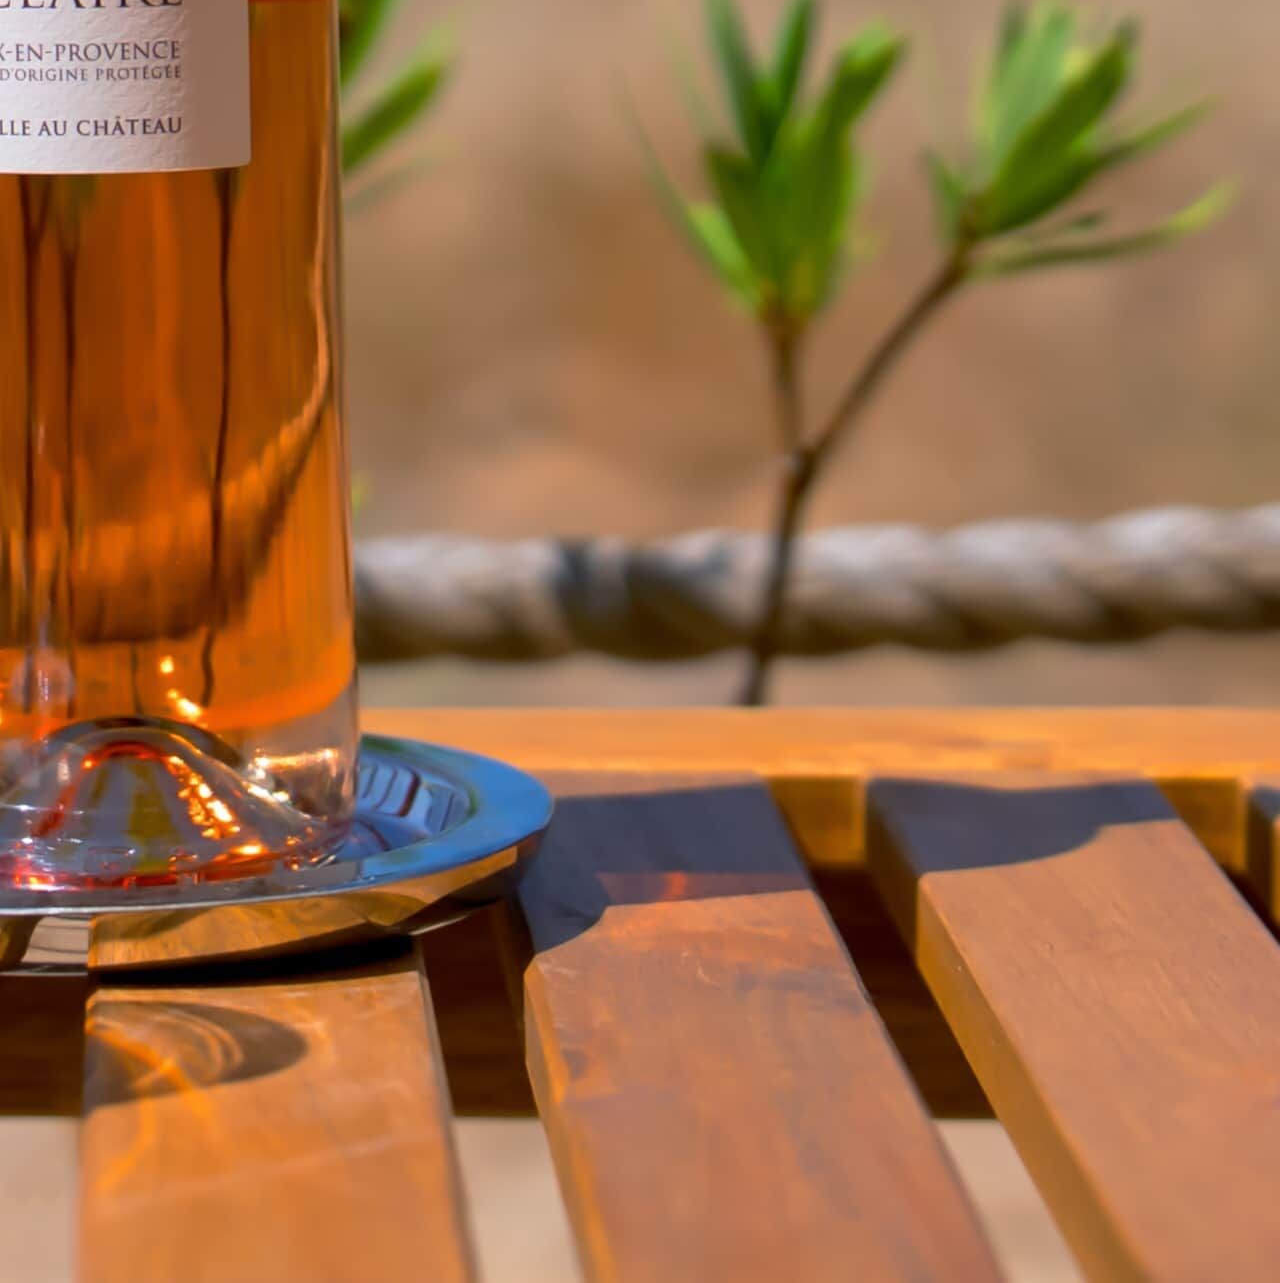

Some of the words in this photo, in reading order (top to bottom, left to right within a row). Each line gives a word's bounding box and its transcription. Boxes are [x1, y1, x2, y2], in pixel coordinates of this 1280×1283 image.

[0, 67, 89, 82] D'ORIGINE
[95, 64, 182, 81] PROTÉGÉE
[37, 120, 68, 137] AU
[76, 115, 183, 137] CHÂTEAU
